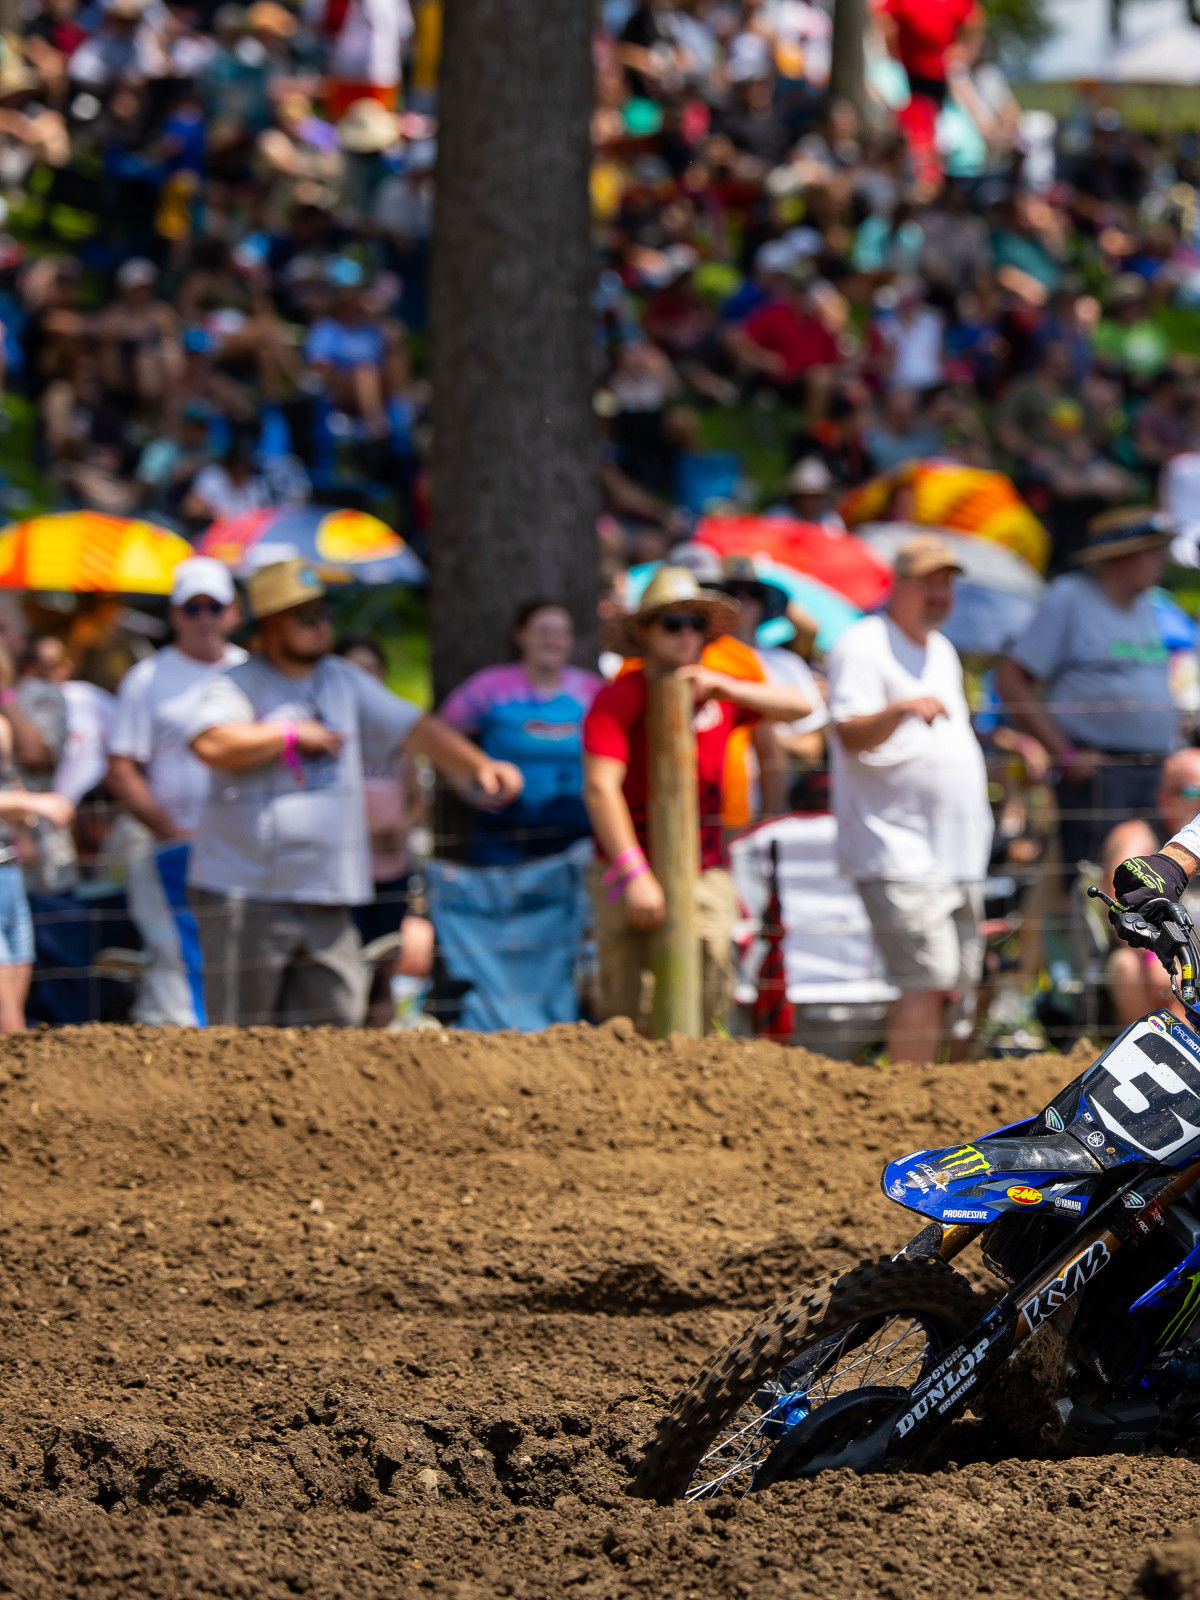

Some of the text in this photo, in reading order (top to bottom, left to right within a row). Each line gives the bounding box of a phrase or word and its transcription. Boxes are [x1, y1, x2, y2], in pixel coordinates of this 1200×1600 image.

[1007, 1187, 1043, 1202] FMF
[1061, 1198, 1082, 1212] YAMAHA
[942, 1209, 988, 1220] PROGRESSIVE
[931, 1344, 968, 1381] CYCRA
[895, 1337, 990, 1439] DUNLOP
[937, 1374, 978, 1416] BRAKING
